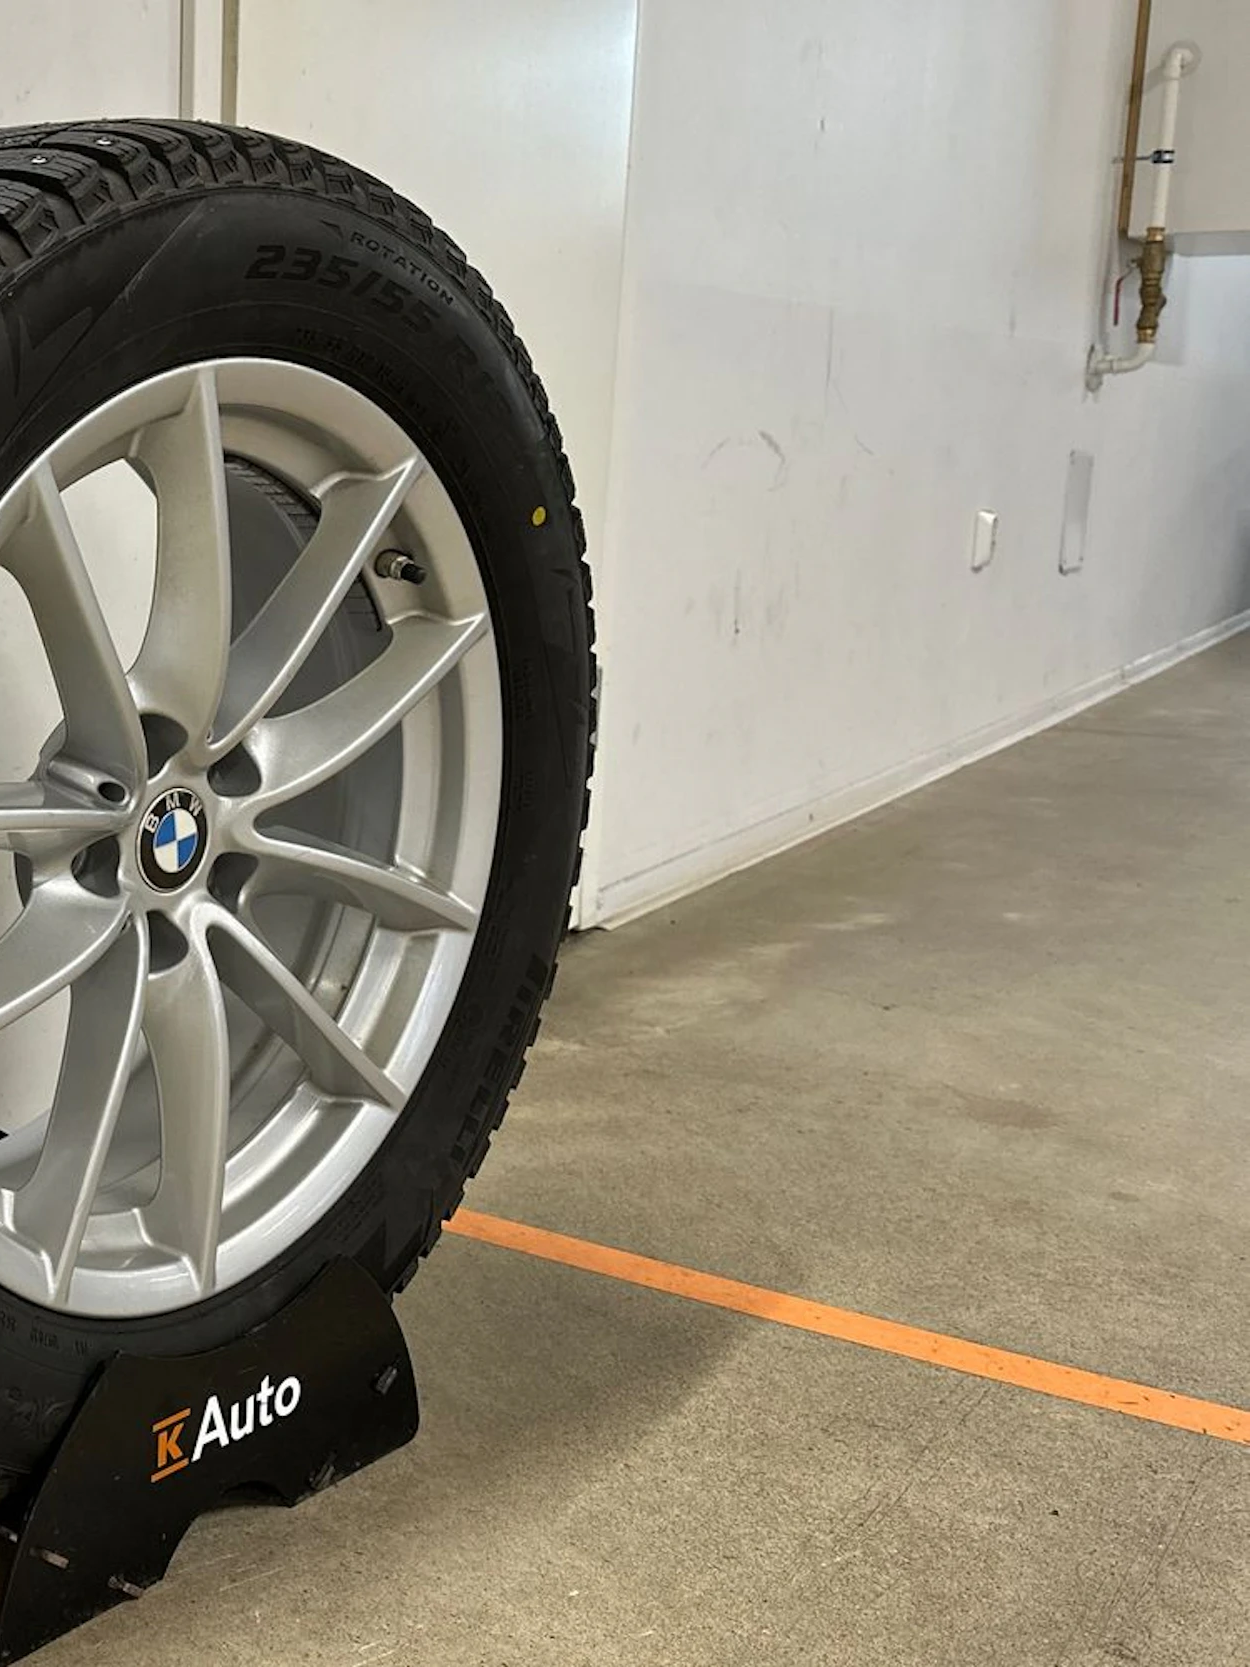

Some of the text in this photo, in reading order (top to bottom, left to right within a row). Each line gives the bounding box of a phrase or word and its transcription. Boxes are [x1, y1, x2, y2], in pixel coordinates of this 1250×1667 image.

[244, 243, 440, 334] 235/55
[349, 230, 454, 306] ROTATION
[144, 791, 204, 833] BMW
[449, 952, 549, 1163] PIRELLI
